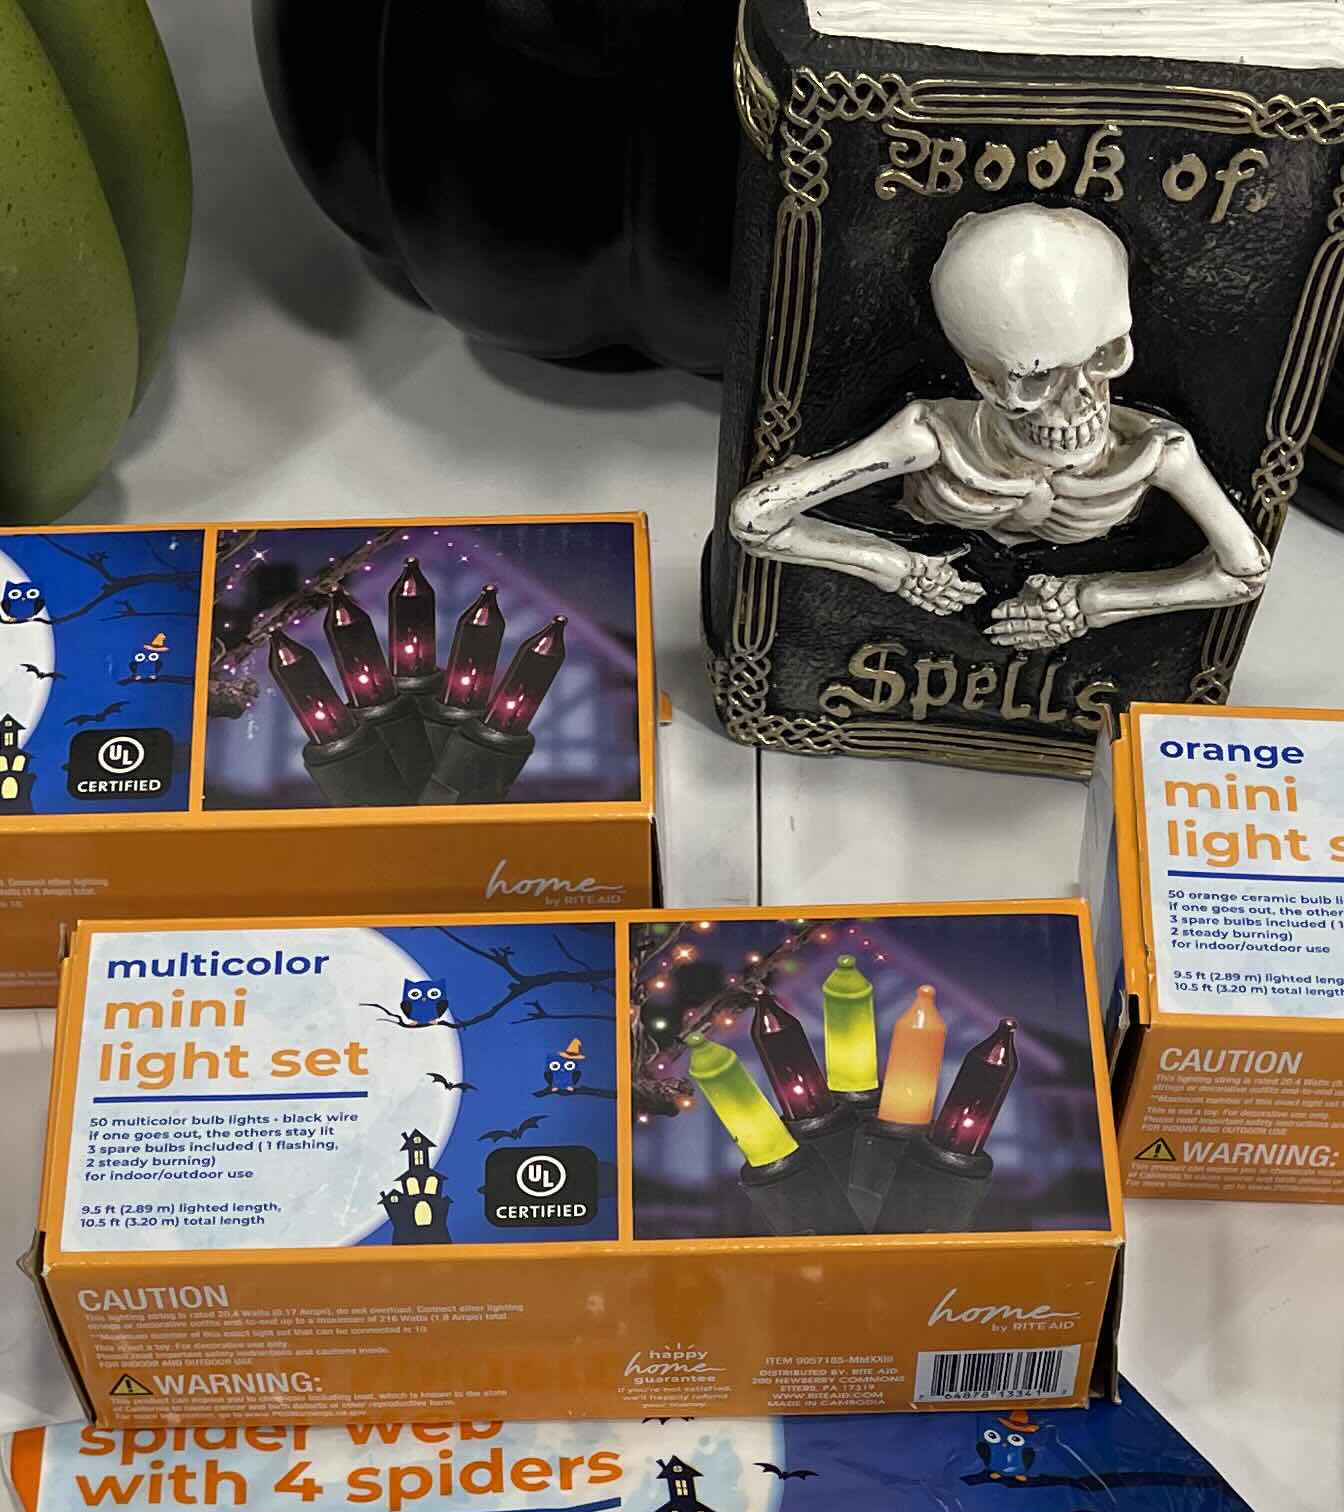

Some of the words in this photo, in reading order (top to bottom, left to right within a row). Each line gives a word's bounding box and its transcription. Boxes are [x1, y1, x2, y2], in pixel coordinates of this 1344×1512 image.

[1163, 148, 1269, 224] of
[1159, 738, 1305, 769] orange
[76, 777, 162, 795] CERTIFIED
[1164, 773, 1298, 812] mini
[1167, 819, 1309, 868] light
[486, 859, 624, 898] home
[1168, 890, 1184, 899] 50
[1188, 891, 1238, 902] orange
[1241, 893, 1296, 903] ceramic
[1301, 894, 1331, 905] bulb
[107, 949, 330, 979] multicolor
[104, 986, 248, 1030] mini
[98, 1041, 249, 1090] light
[270, 1039, 369, 1078] set
[1158, 1047, 1303, 1075] CAUTION
[89, 1117, 108, 1127] 50
[112, 1115, 187, 1126] multicolor
[191, 1115, 225, 1126] bulb
[228, 1114, 269, 1125] lights
[282, 1113, 322, 1123] black
[327, 1112, 358, 1122] wire
[87, 1144, 96, 1154] 3
[99, 1144, 140, 1155] spare
[145, 1142, 185, 1153] bulbs
[189, 1141, 253, 1152] included
[276, 1139, 339, 1151] flashing,
[89, 1130, 99, 1141] if
[102, 1132, 130, 1140] one
[134, 1131, 169, 1142] goes
[174, 1129, 202, 1139] out,
[206, 1128, 230, 1138] the
[234, 1127, 282, 1138] others
[285, 1127, 316, 1138] stay
[320, 1126, 335, 1136] lit
[86, 1158, 95, 1168] 2
[98, 1157, 148, 1169] steady
[152, 1155, 216, 1168] burning)
[1182, 1141, 1339, 1167] WARNING:
[85, 1171, 106, 1182] for
[110, 1169, 223, 1181] indoor/outdoor
[227, 1170, 254, 1179] use
[80, 1218, 106, 1228] 10.5
[110, 1217, 120, 1227] ft
[125, 1216, 157, 1228] (3.20
[161, 1216, 180, 1227] m)
[183, 1216, 216, 1226] total
[220, 1215, 265, 1226] length
[81, 1205, 102, 1215] 9.5
[105, 1205, 117, 1214] ft
[120, 1203, 153, 1215] (2.89
[157, 1203, 175, 1215] m)
[179, 1202, 228, 1214] lighted
[232, 1202, 282, 1213] length,
[494, 1201, 587, 1221] CERTIFIED
[77, 1283, 230, 1313] CAUTION
[928, 1288, 1080, 1327] home
[623, 1351, 727, 1377] home
[649, 1350, 708, 1361] happy
[153, 1370, 323, 1395] WARNING:
[633, 1375, 716, 1385] guarantee
[76, 1462, 246, 1507] with
[273, 1460, 322, 1502] 4
[346, 1448, 623, 1512] spiders
